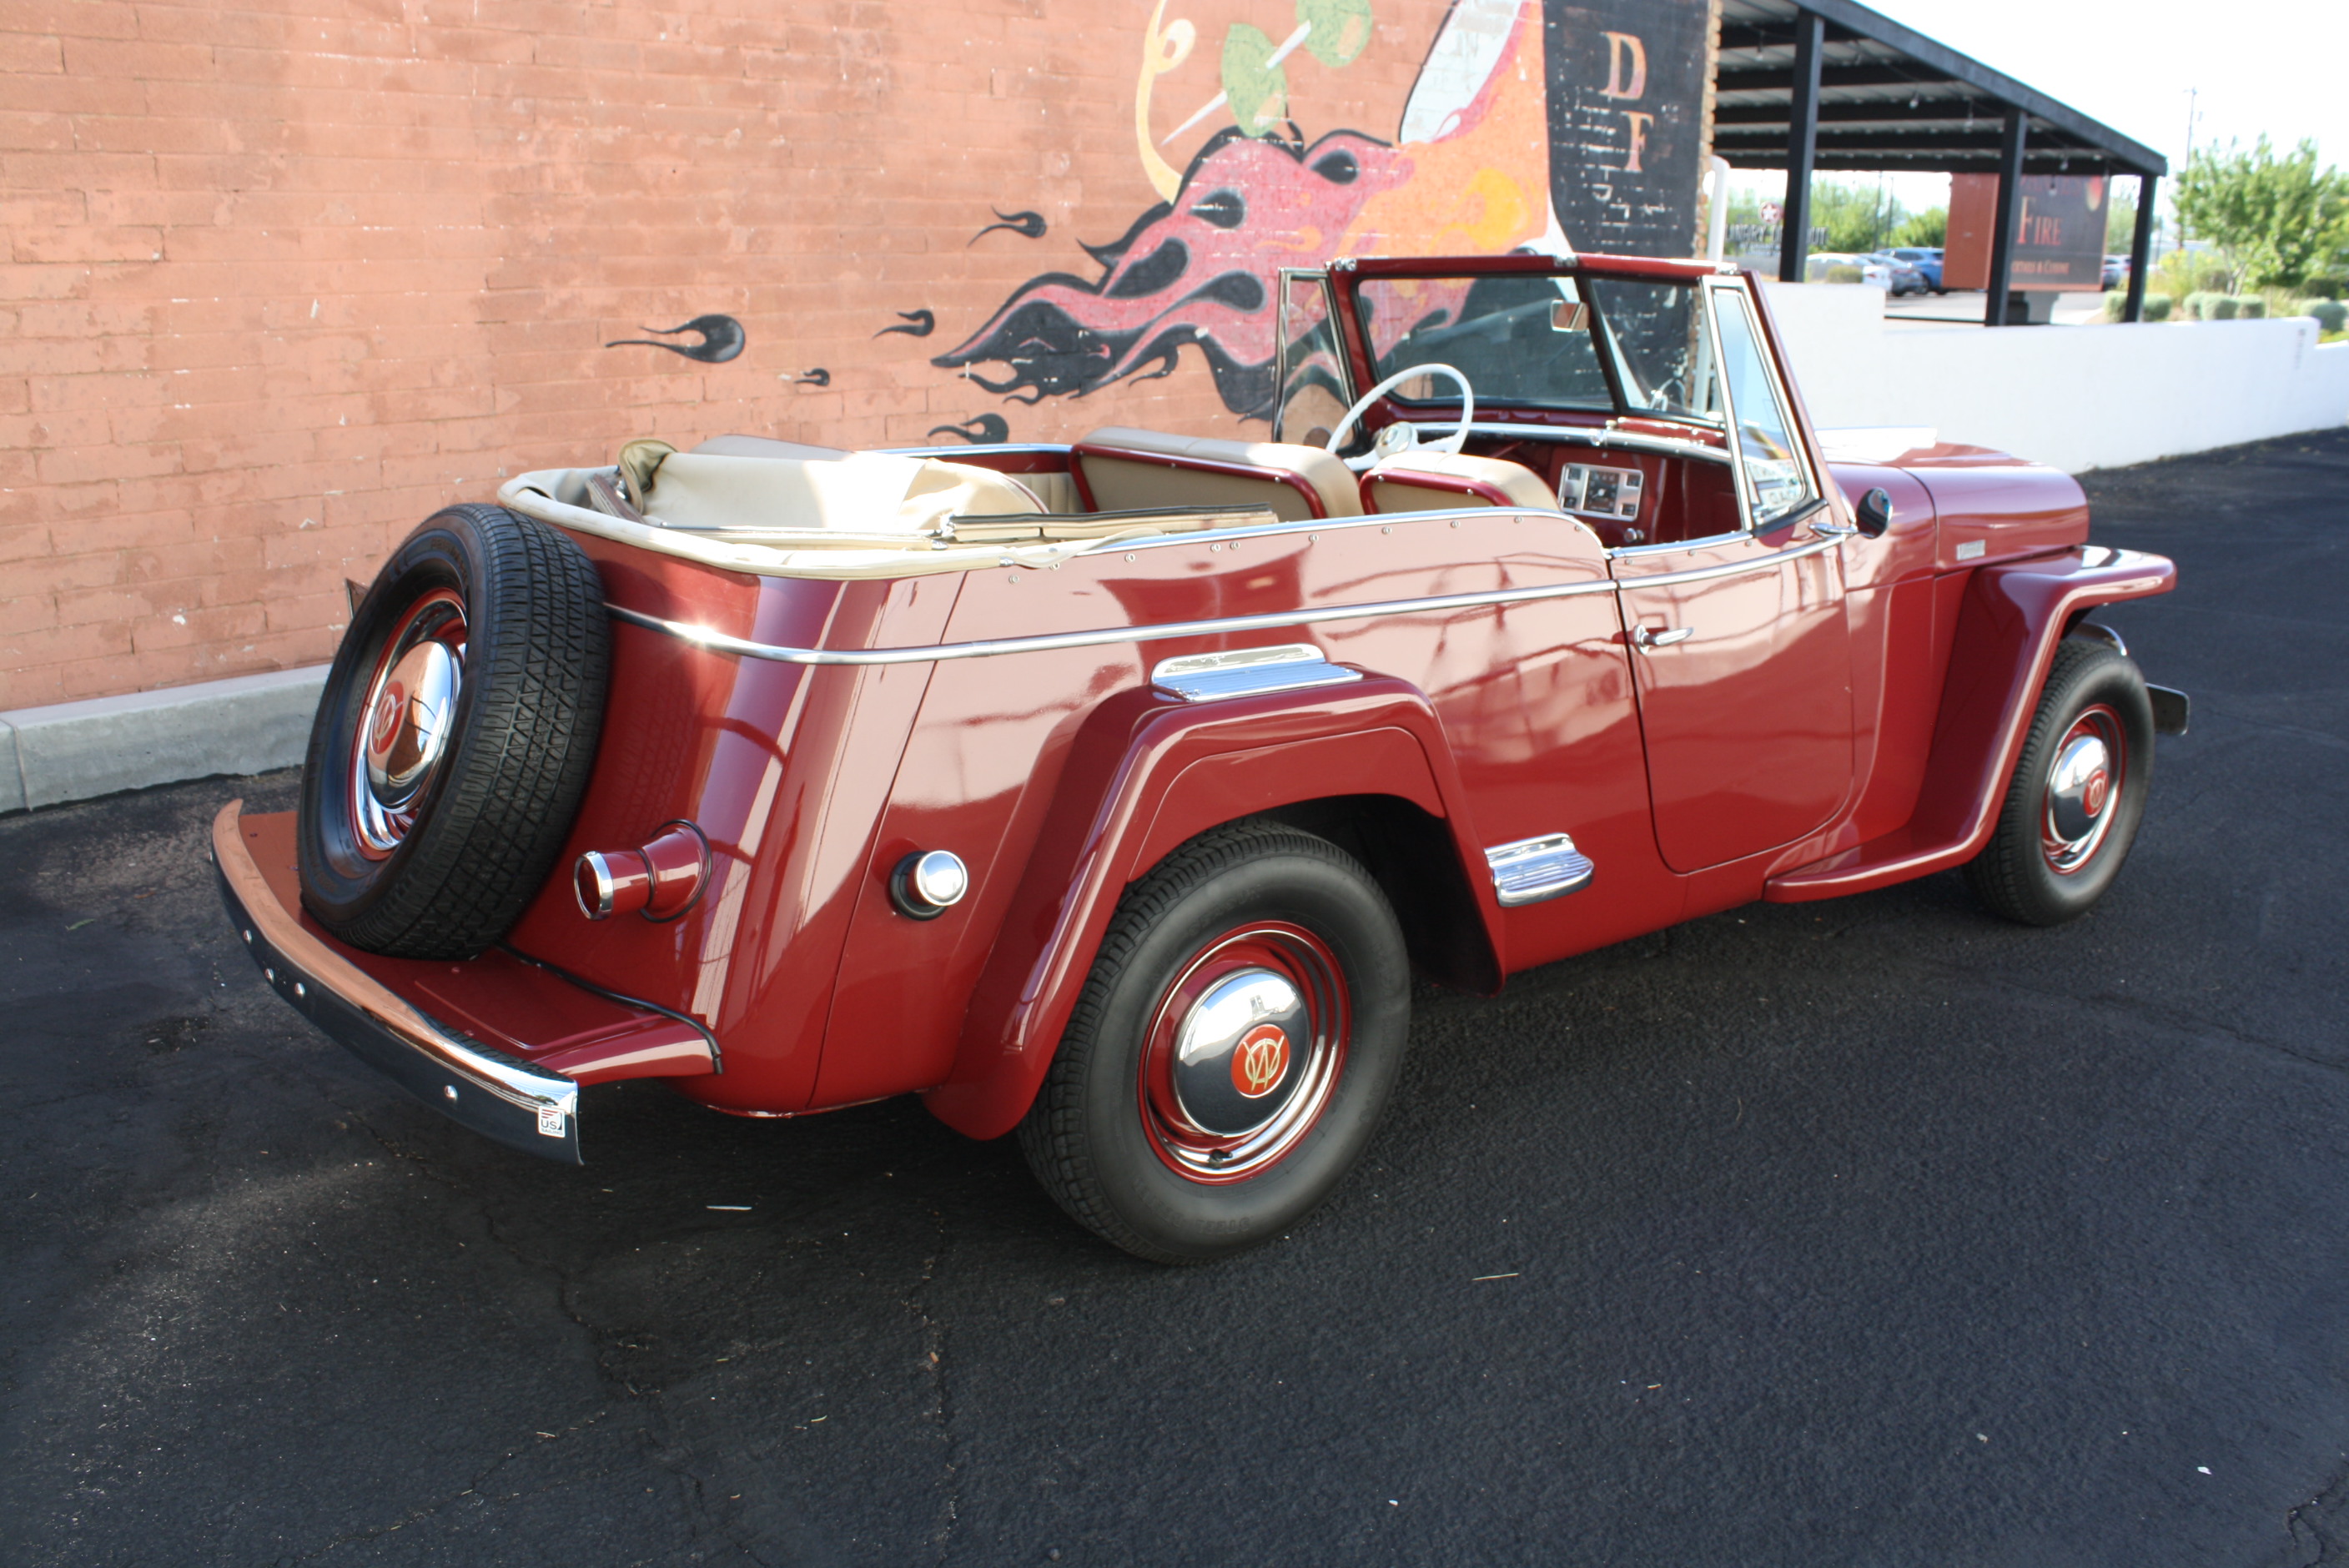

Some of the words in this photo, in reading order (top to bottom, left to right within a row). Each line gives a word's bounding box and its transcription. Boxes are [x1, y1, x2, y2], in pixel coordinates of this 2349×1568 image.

[1598, 31, 1647, 100] D
[1620, 111, 1654, 173] F
[541, 1119, 557, 1129] US
